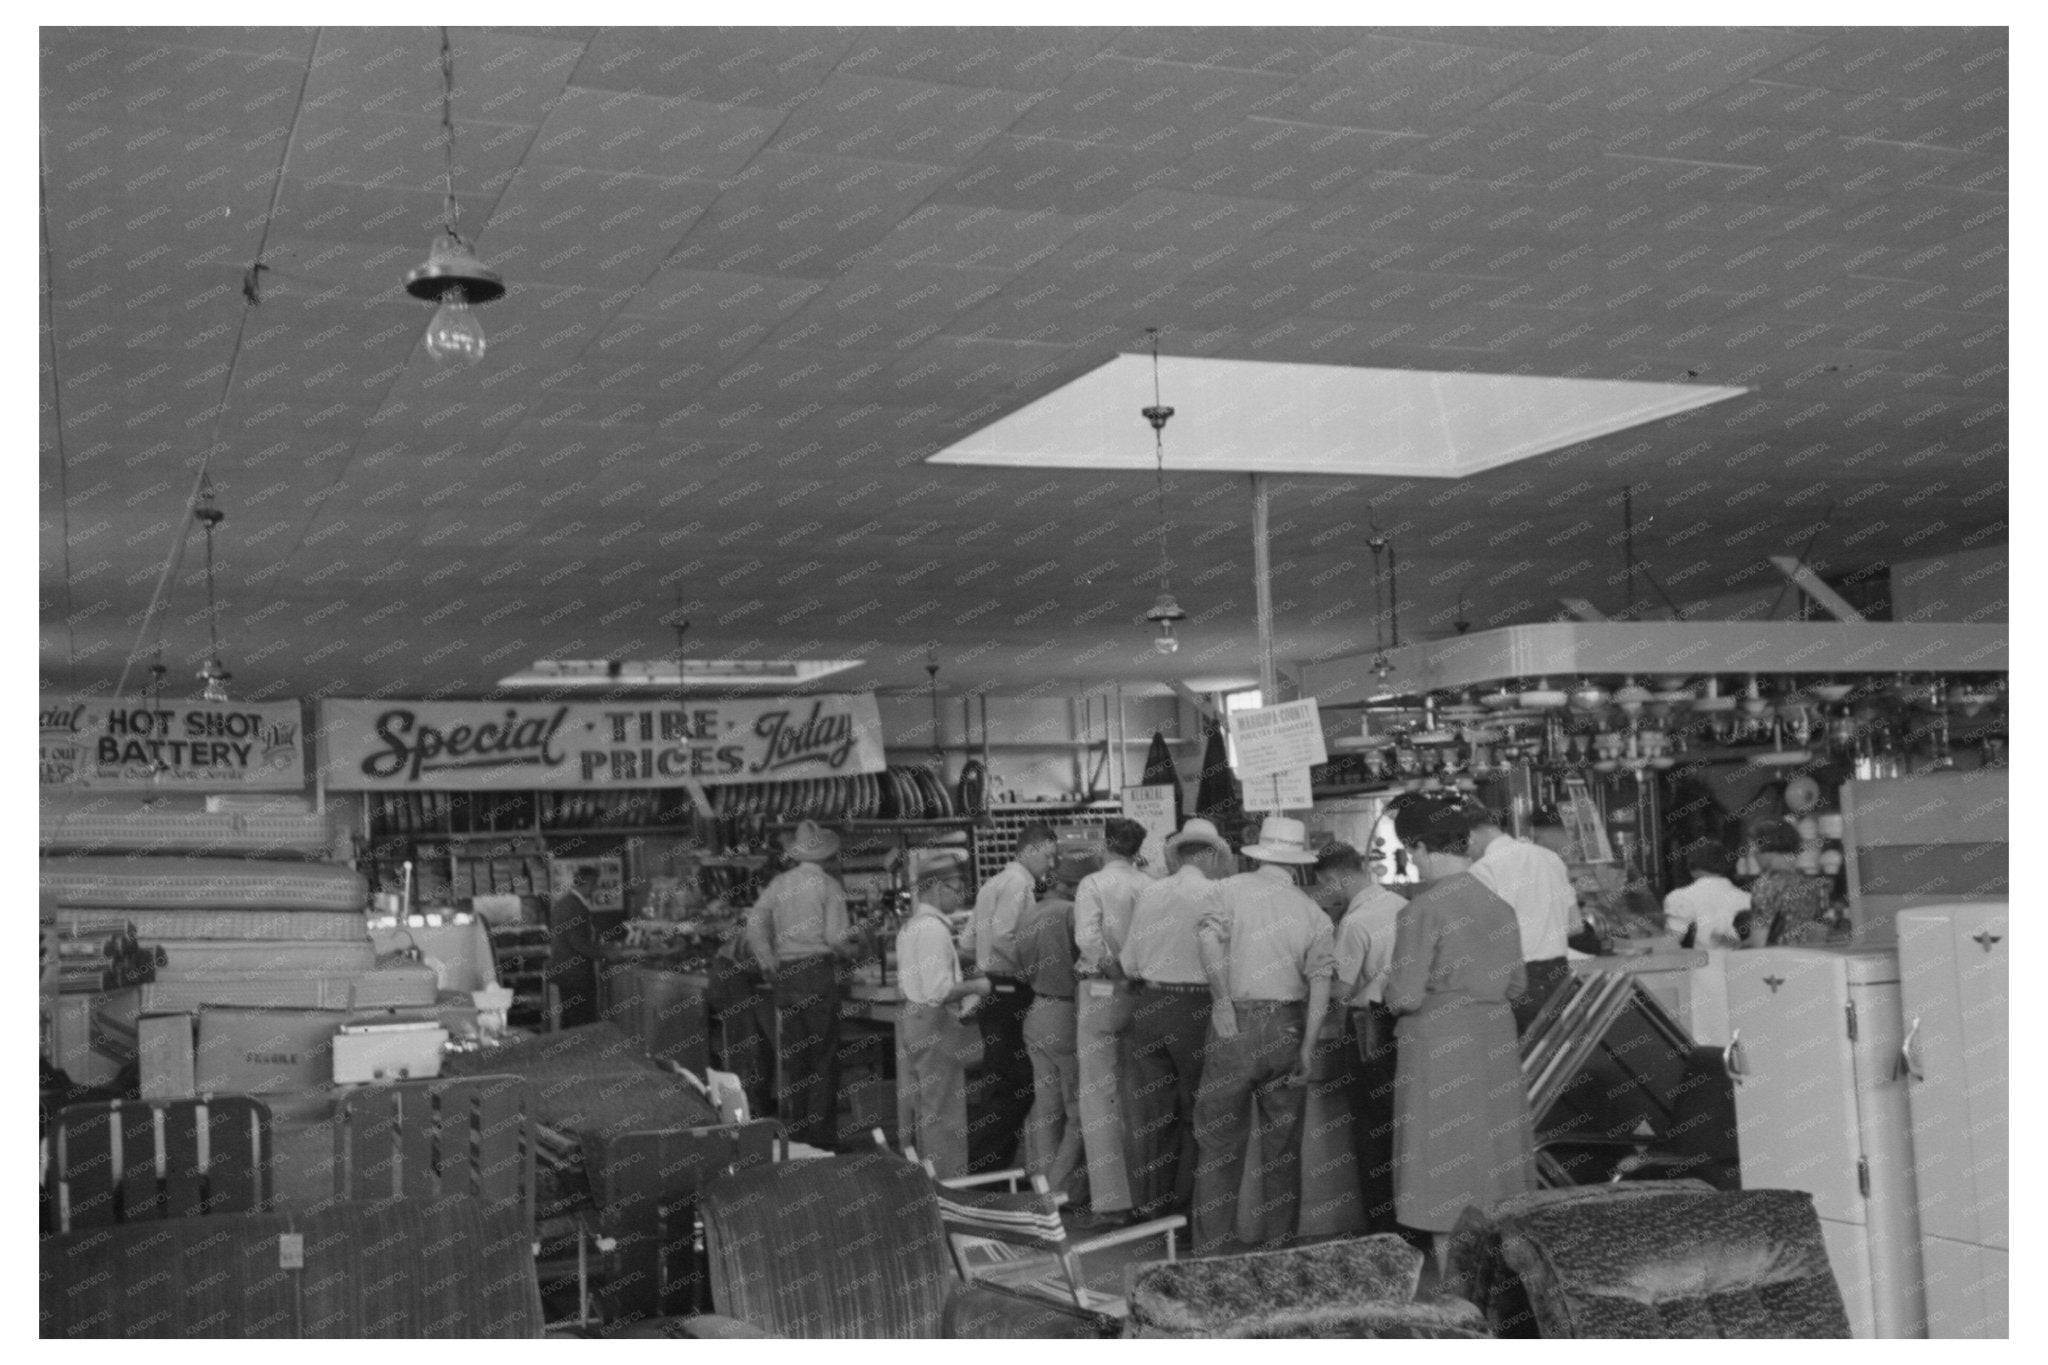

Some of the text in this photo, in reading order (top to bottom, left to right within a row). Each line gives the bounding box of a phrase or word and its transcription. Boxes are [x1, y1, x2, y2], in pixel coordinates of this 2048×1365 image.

[108, 708, 263, 738] HOT SHOT
[604, 708, 719, 743] TIRE
[751, 701, 857, 774] Today
[99, 736, 253, 767] BATTERY
[361, 705, 569, 782] Special
[580, 745, 745, 782] PRICES
